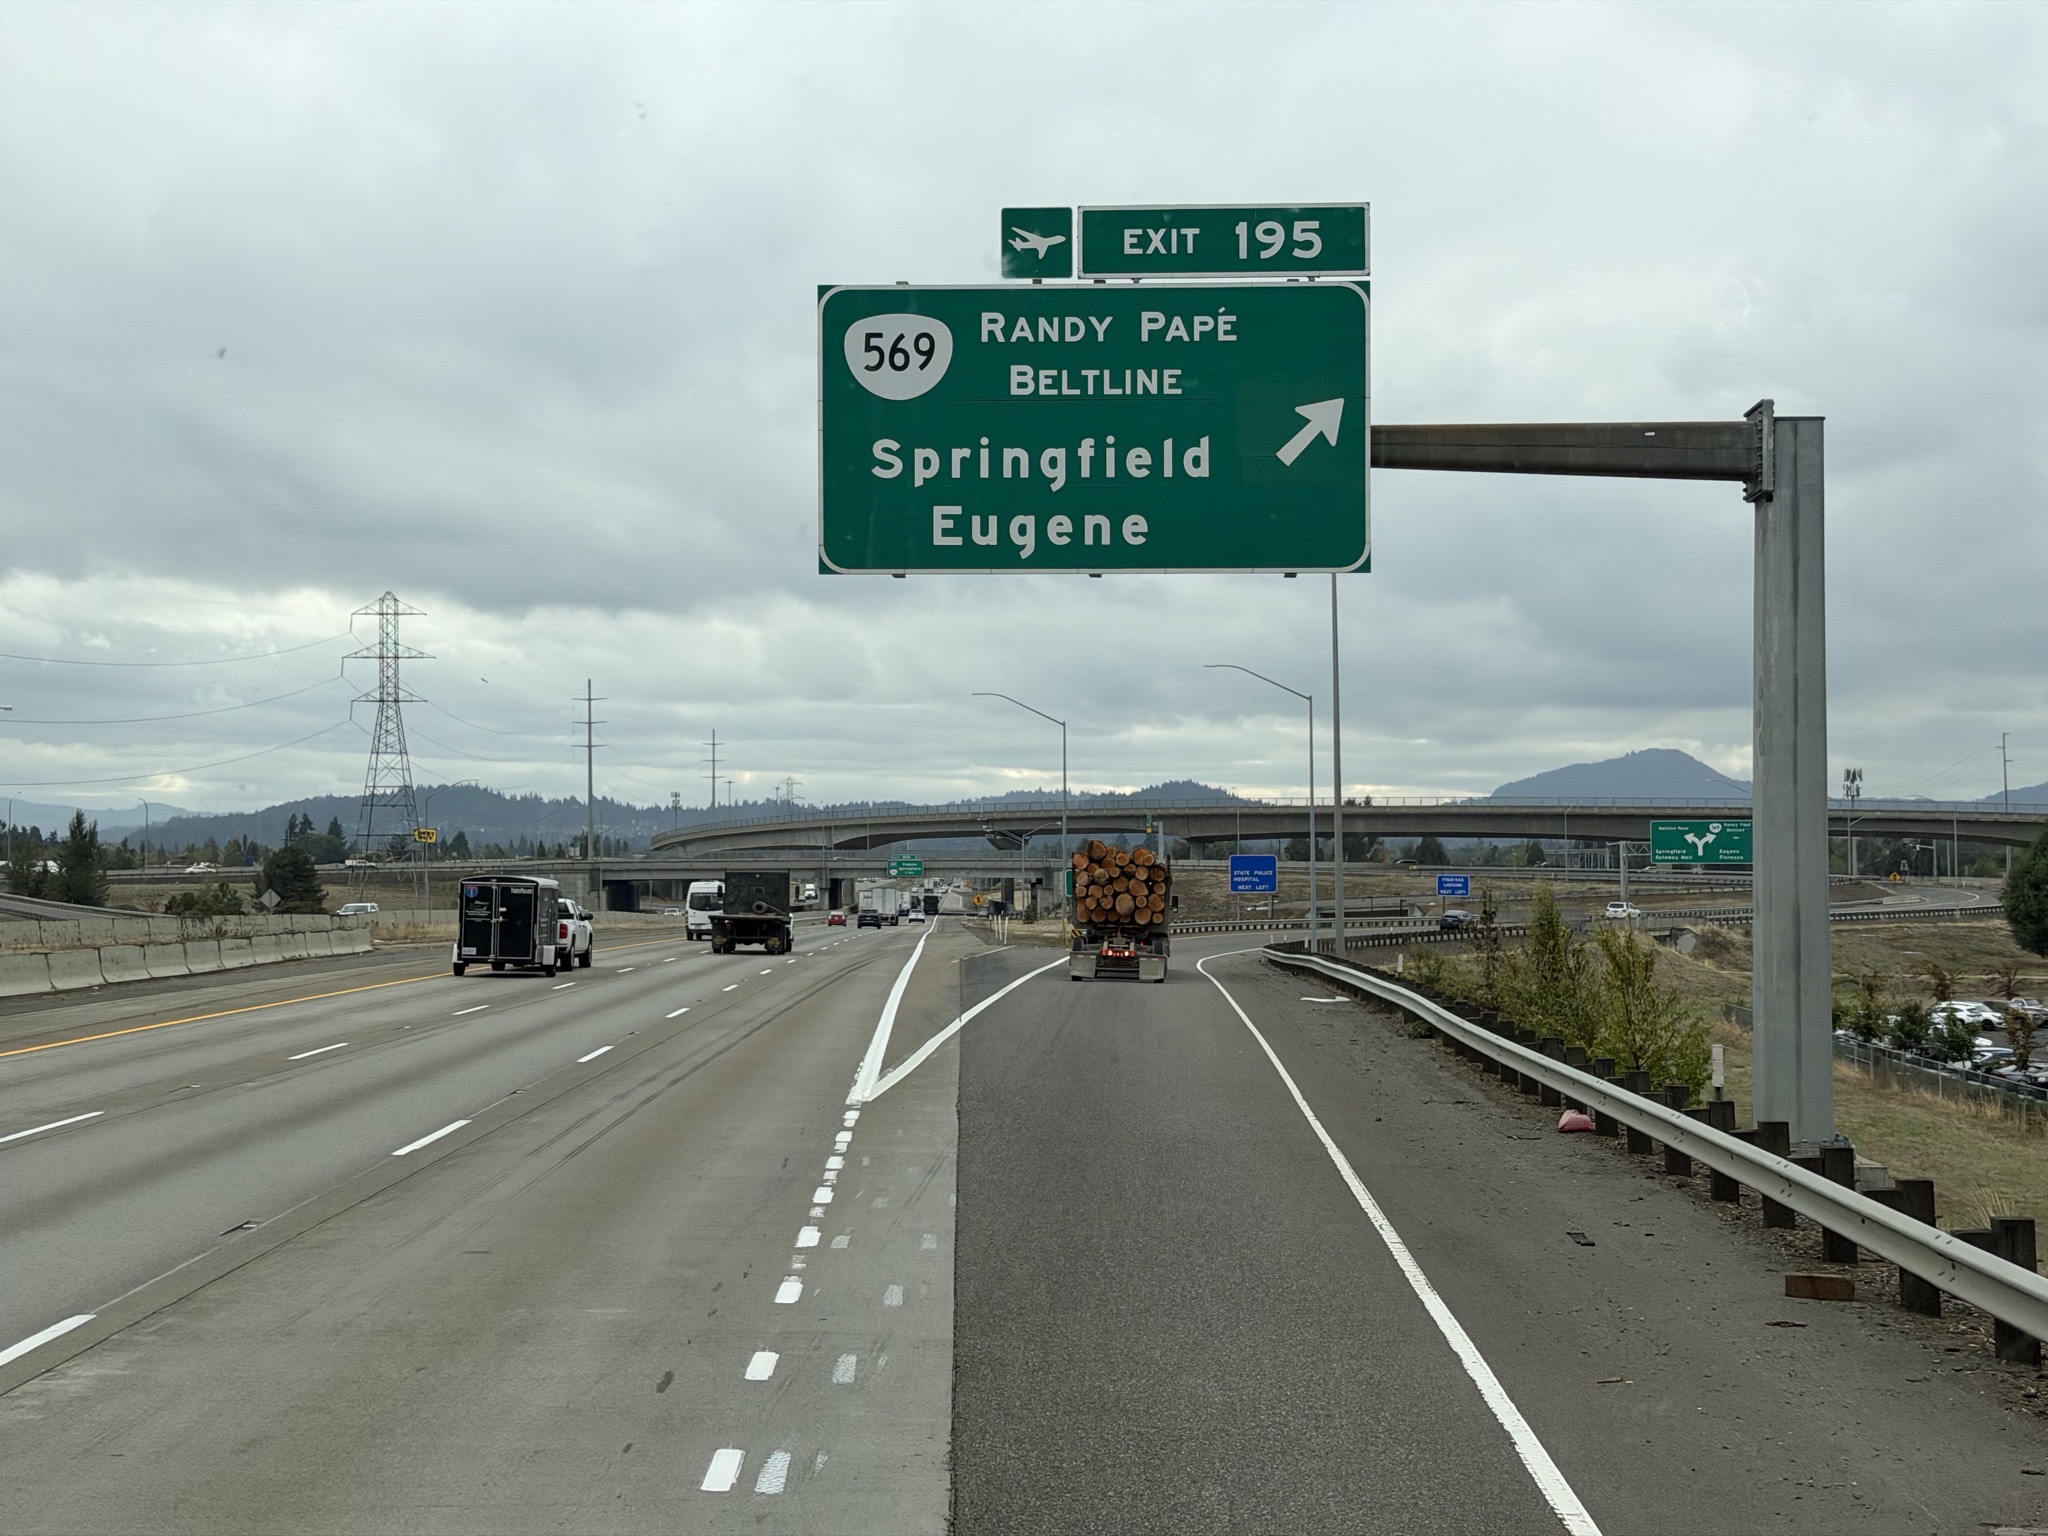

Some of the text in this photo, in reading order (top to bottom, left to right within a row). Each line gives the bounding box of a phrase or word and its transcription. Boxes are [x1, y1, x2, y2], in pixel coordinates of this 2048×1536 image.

[1124, 220, 1322, 260] EXIT 195
[981, 306, 1237, 343] RANDY PAPÉ
[863, 331, 936, 373] 569
[1010, 364, 1182, 396] BELTLINE
[871, 435, 1210, 492] Springfield
[933, 505, 1149, 560] Eugene
